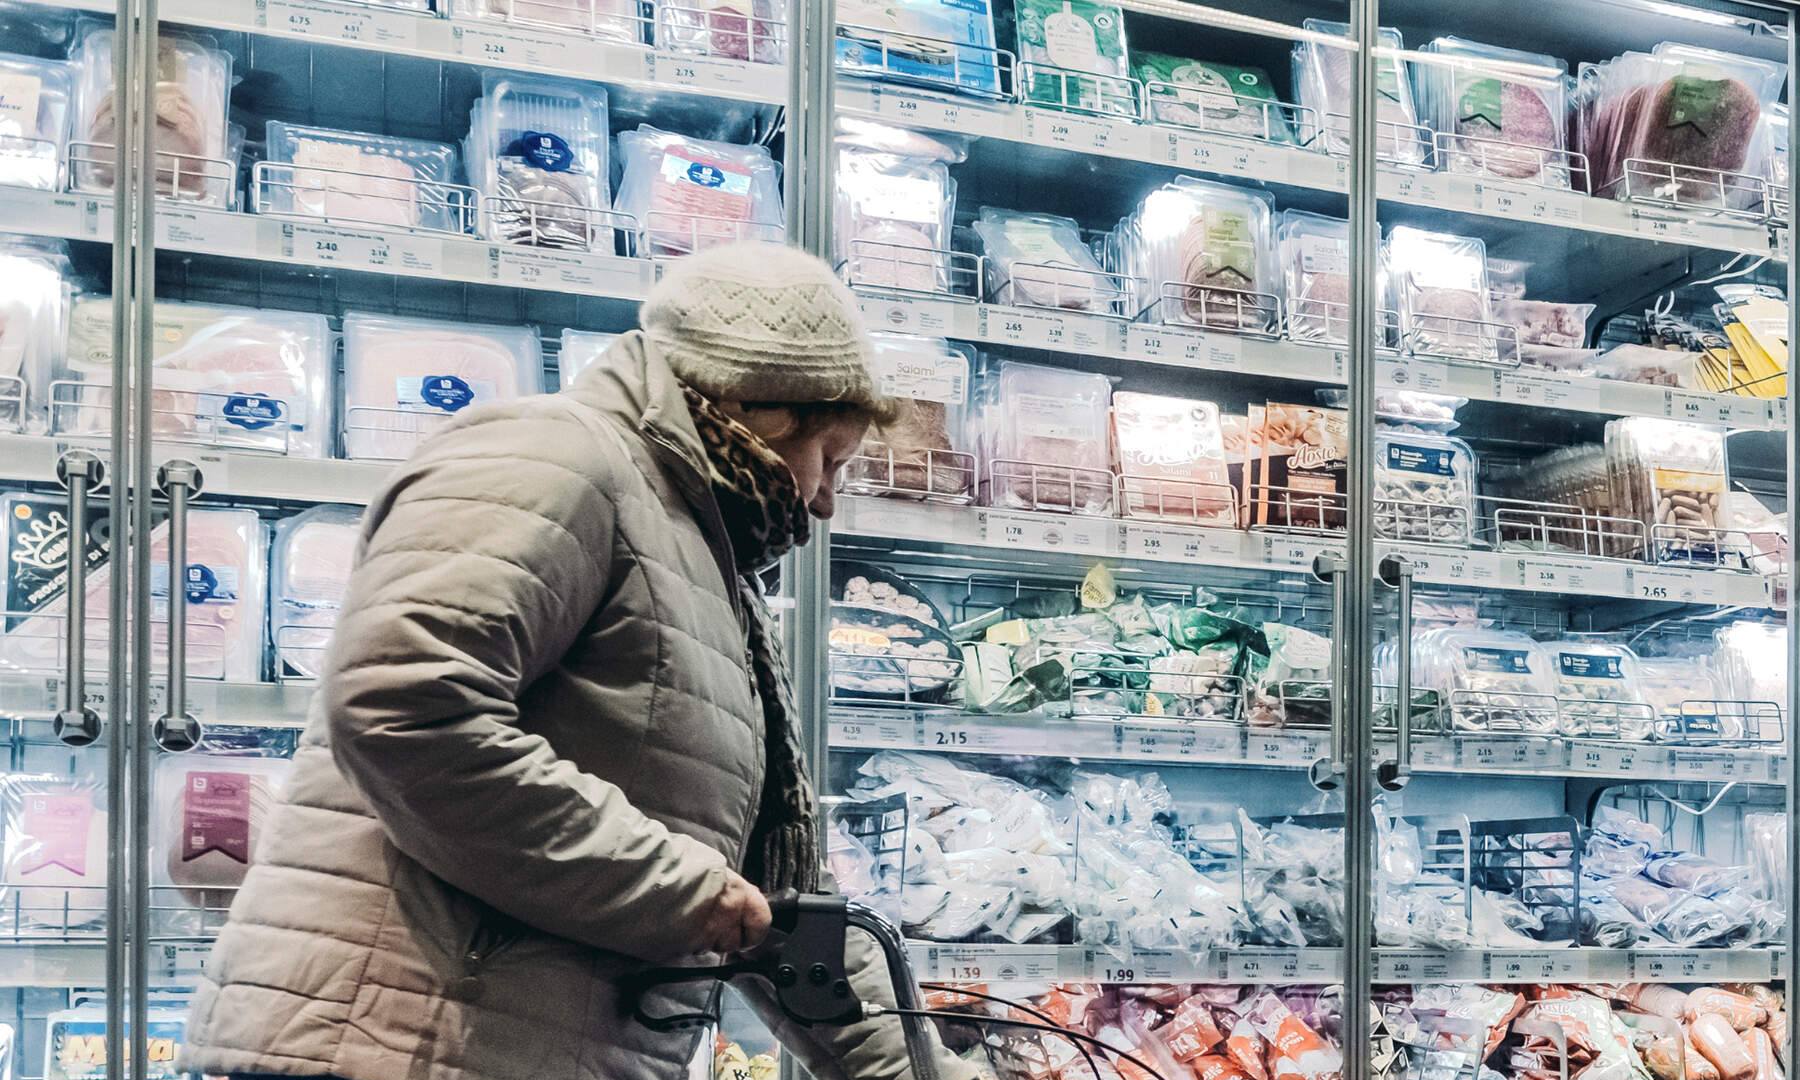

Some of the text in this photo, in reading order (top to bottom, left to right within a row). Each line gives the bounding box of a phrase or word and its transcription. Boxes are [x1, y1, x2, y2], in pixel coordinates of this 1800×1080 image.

[289, 15, 311, 26] 4.75
[485, 43, 505, 54] 2.24
[675, 67, 695, 79] 2.75
[900, 101, 917, 111] 2.69
[316, 241, 338, 253] 2.40
[1005, 322, 1023, 333] 2.65
[896, 361, 936, 377] Salami
[1287, 443, 1337, 469] Aoste
[1005, 526, 1023, 536] 1.78
[1643, 586, 1667, 599] 2.65
[936, 731, 967, 746] 2,15
[950, 967, 982, 980] 1.39
[1105, 968, 1135, 983] 1.99
